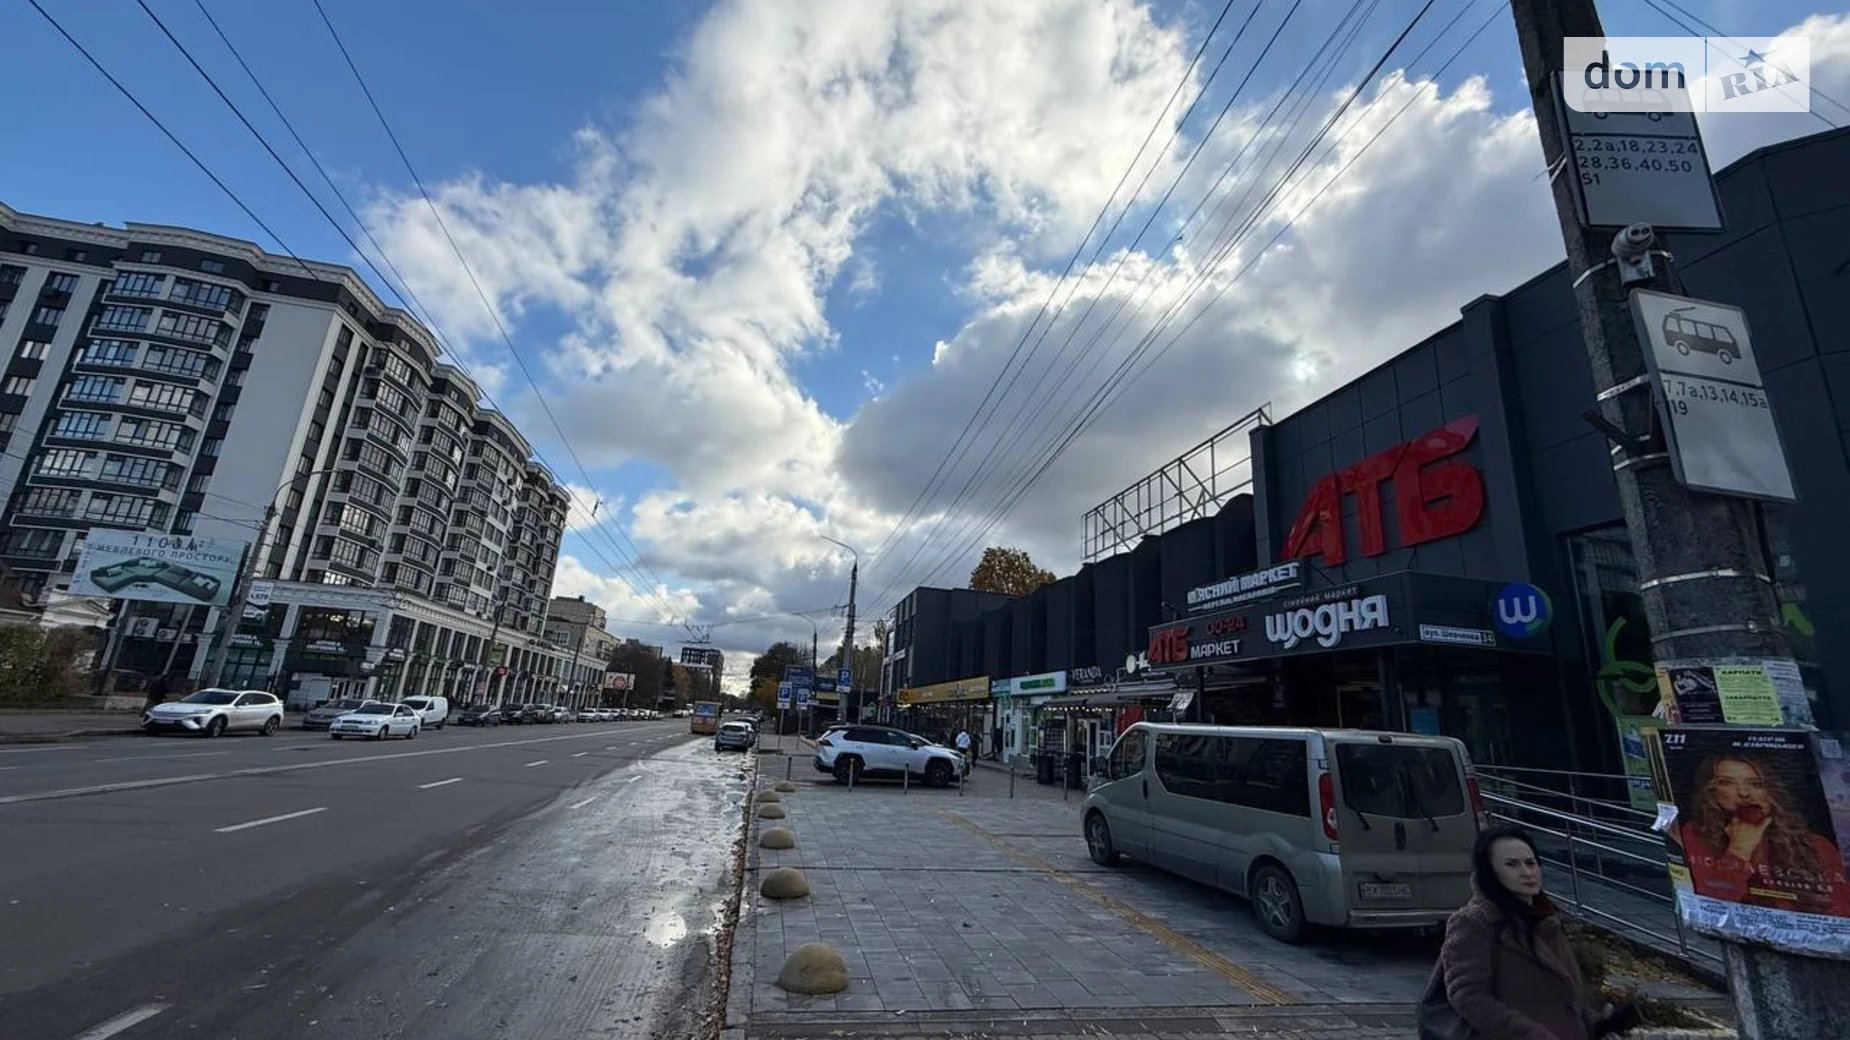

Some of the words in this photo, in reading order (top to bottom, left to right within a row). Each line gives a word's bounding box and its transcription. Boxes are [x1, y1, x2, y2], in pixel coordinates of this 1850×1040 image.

[1582, 173, 1600, 186] 51
[1671, 400, 1688, 416] 19
[1281, 413, 1485, 568] АТБ
[1240, 562, 1300, 591] МАРКЕТ
[1147, 625, 1190, 664] АТБ
[1190, 639, 1241, 660] МАРКЕТ
